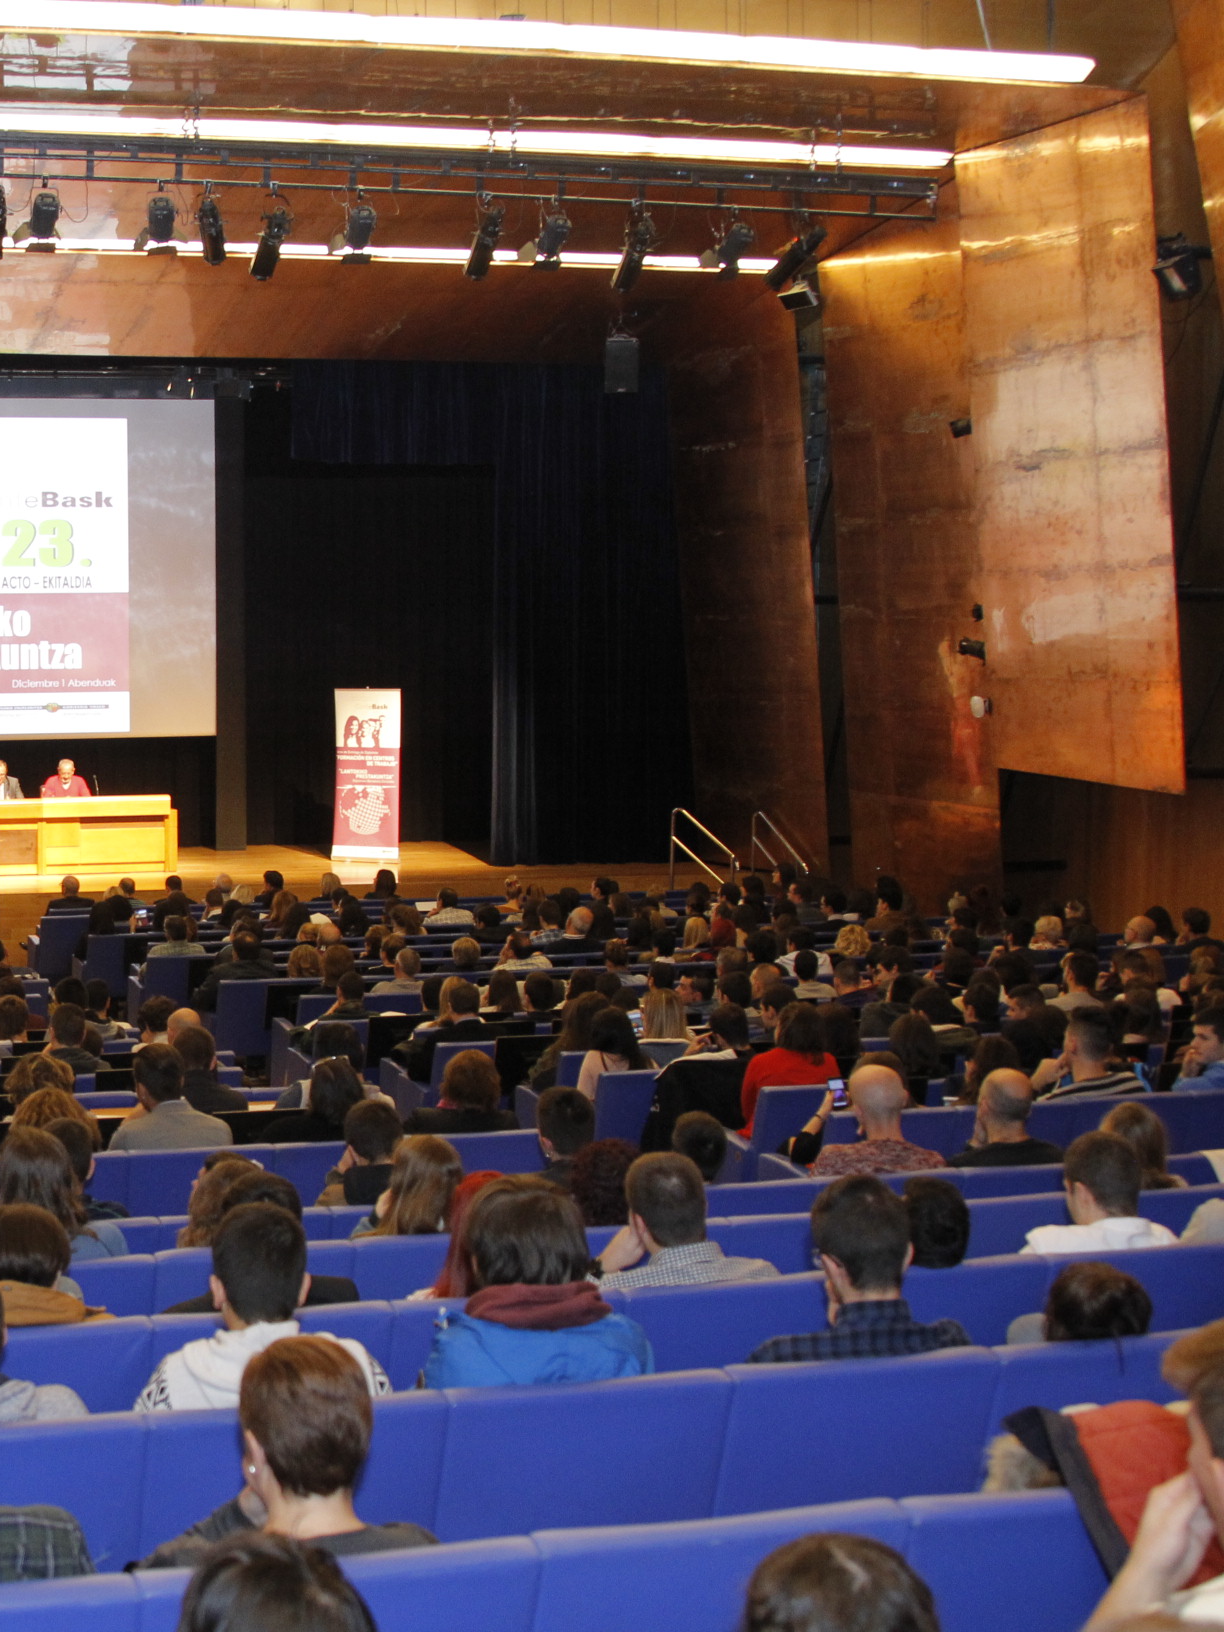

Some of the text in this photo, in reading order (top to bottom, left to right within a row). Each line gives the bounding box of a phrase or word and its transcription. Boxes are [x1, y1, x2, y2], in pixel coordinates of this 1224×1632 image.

[1, 519, 93, 567] 23.
[2, 576, 31, 589] ACTO
[43, 576, 92, 588] EKITALDIA
[11, 679, 59, 689] Diciembre
[67, 678, 116, 688] Abenduak
